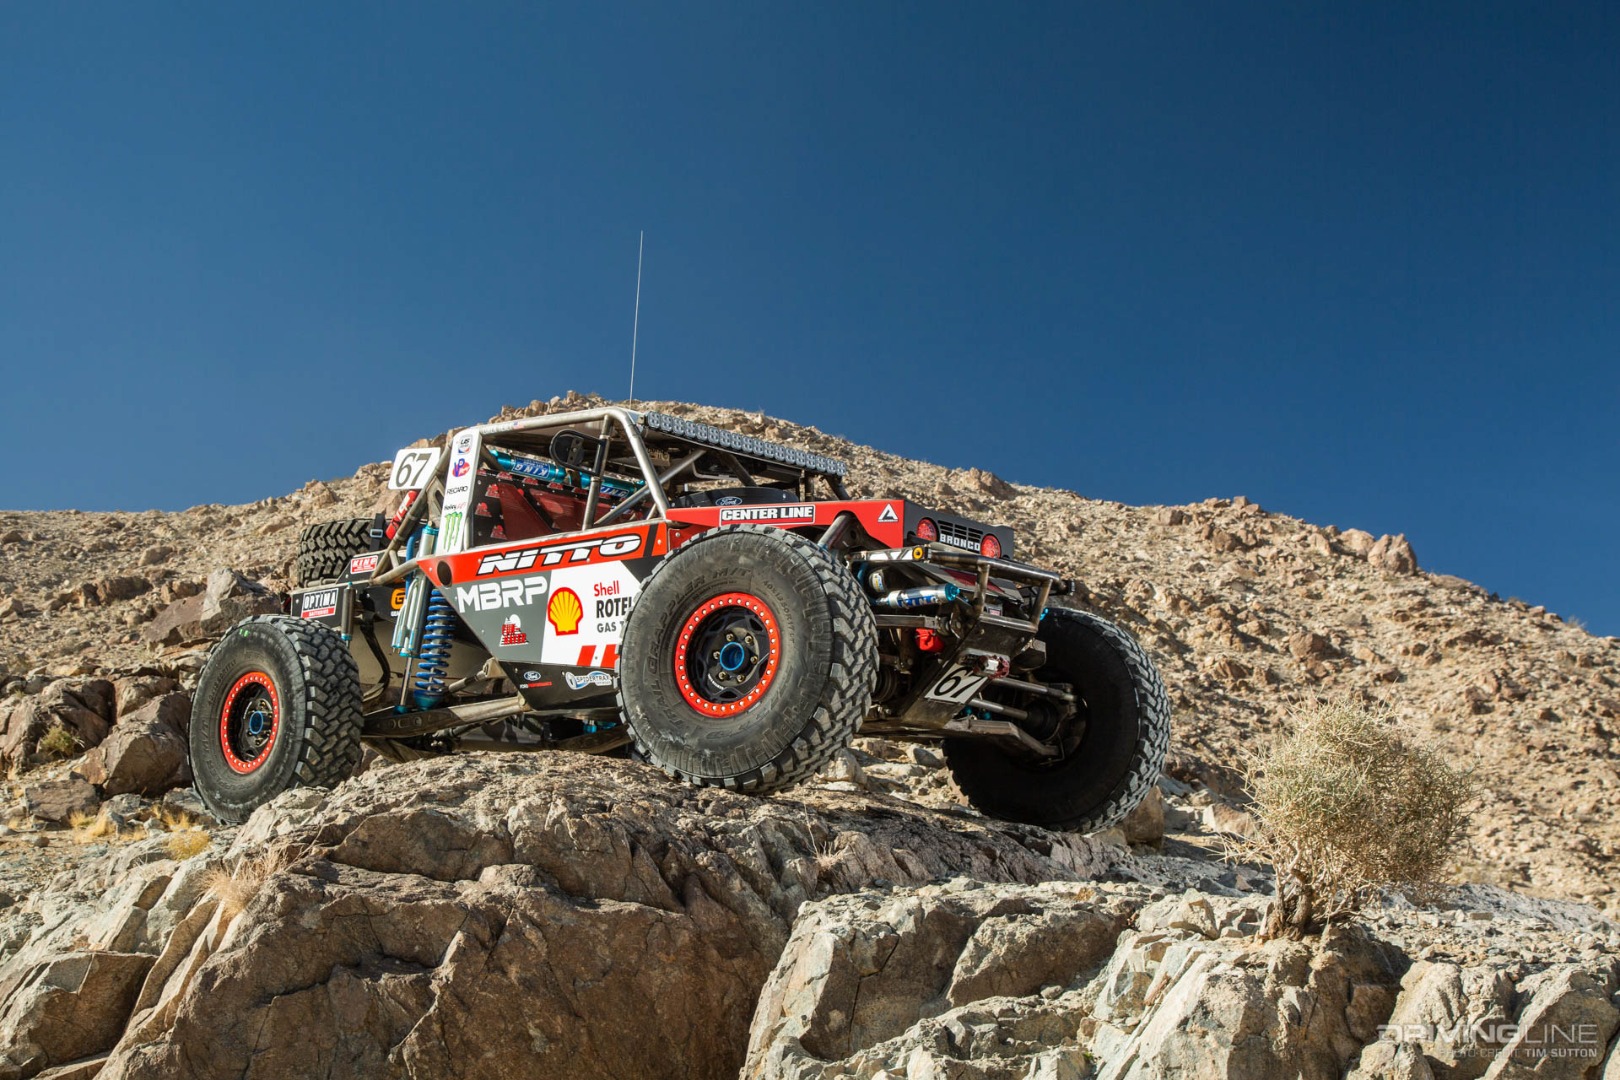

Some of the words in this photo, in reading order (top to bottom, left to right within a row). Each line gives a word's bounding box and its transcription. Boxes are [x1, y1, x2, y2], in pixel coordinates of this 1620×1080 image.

[396, 452, 432, 487] 67
[514, 463, 549, 477] KING
[721, 498, 737, 506] Ford
[722, 508, 777, 520] CENTER
[780, 506, 813, 518] LINE
[940, 533, 980, 551] BRONCO
[476, 533, 642, 576] NITTO
[456, 576, 548, 613] MBRP
[594, 580, 620, 597] Shell
[304, 591, 336, 610] OPTIMA
[597, 622, 617, 633] GAS
[934, 667, 984, 698] 67
